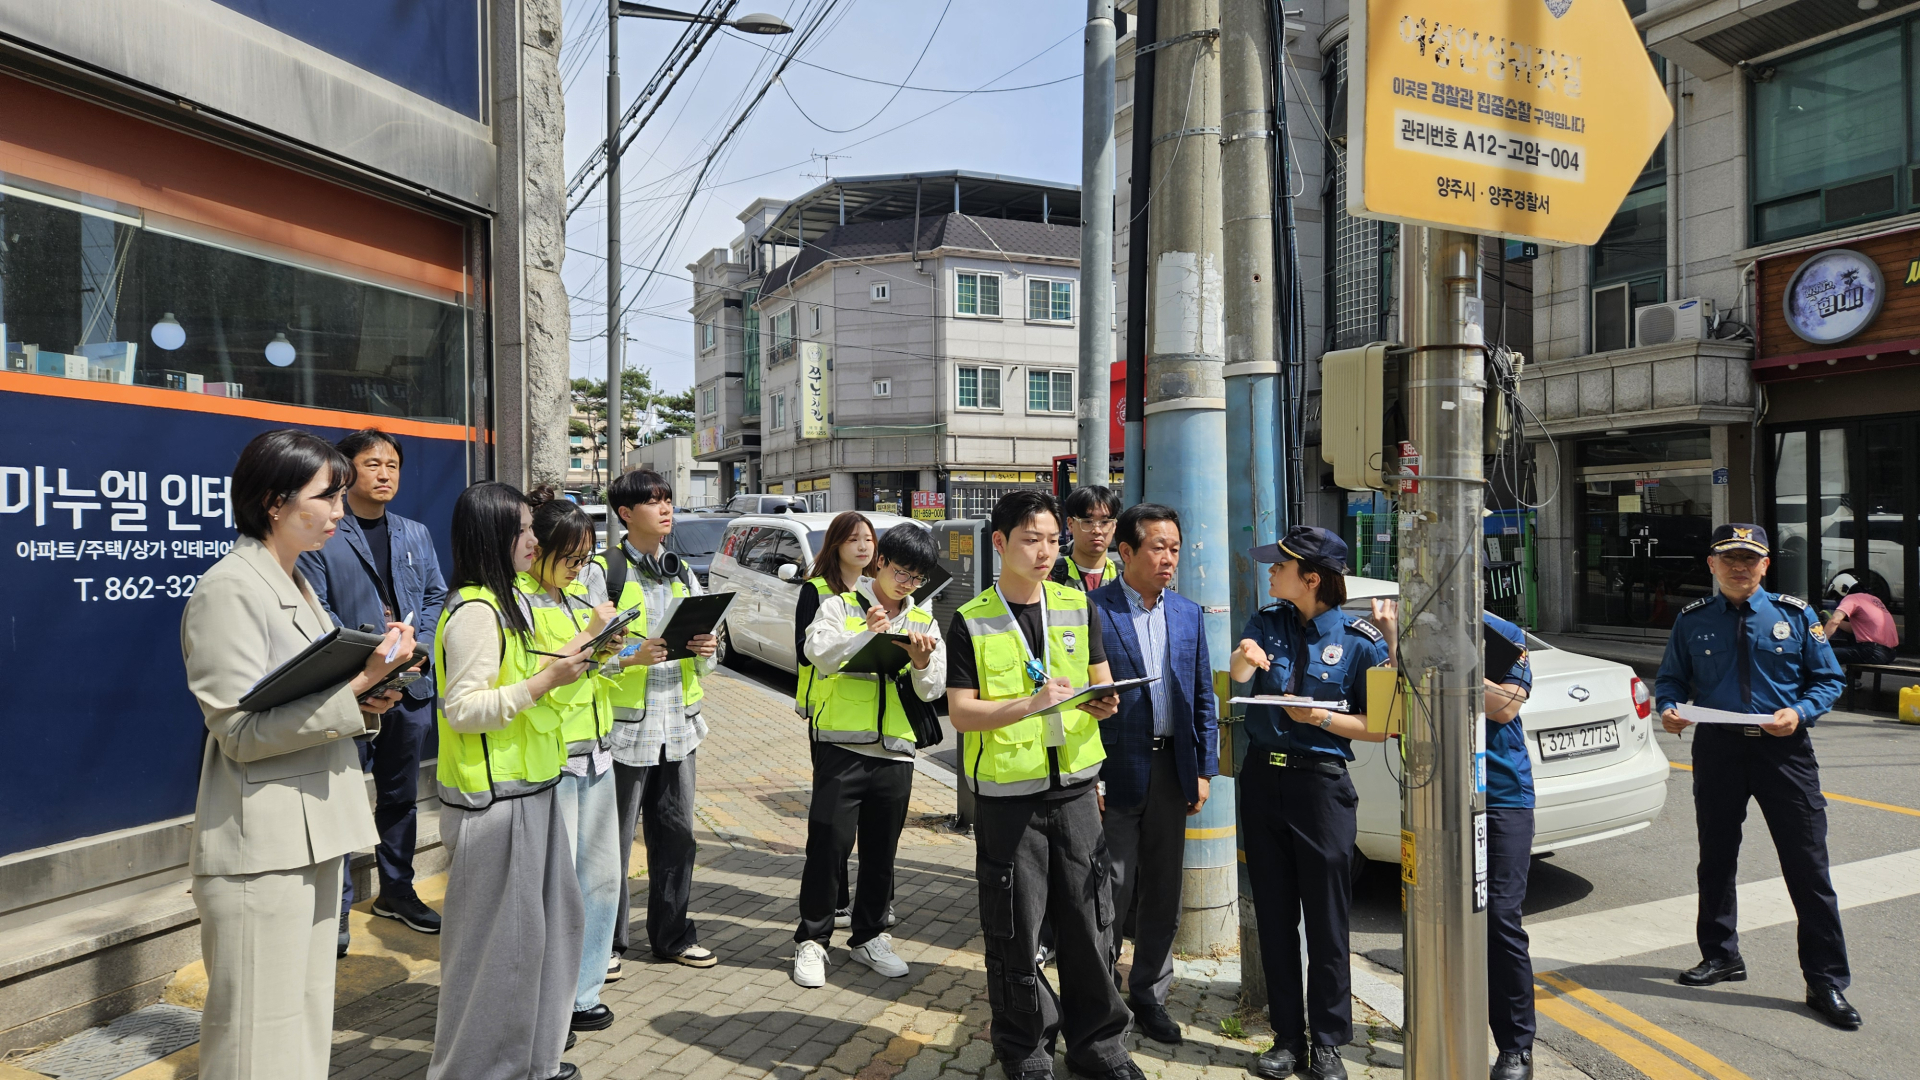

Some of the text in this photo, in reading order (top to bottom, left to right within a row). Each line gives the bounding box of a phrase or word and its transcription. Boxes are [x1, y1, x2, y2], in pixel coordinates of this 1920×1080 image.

[1393, 77, 1585, 133] 이곳은 경찰관 집중순찰 구역입니다
[1401, 118, 1579, 171] 관리번호 A12-고암-004
[1437, 176, 1475, 202] 양주시
[1488, 185, 1549, 214] 양주경찰서
[1817, 286, 1863, 318] 힘내!
[1717, 475, 1728, 483] 26
[0, 465, 238, 531] 마누엘 인테
[16, 540, 167, 561] 아파트/주택/상가
[73, 574, 202, 602] T. 862-32
[1580, 724, 1611, 747] 2773
